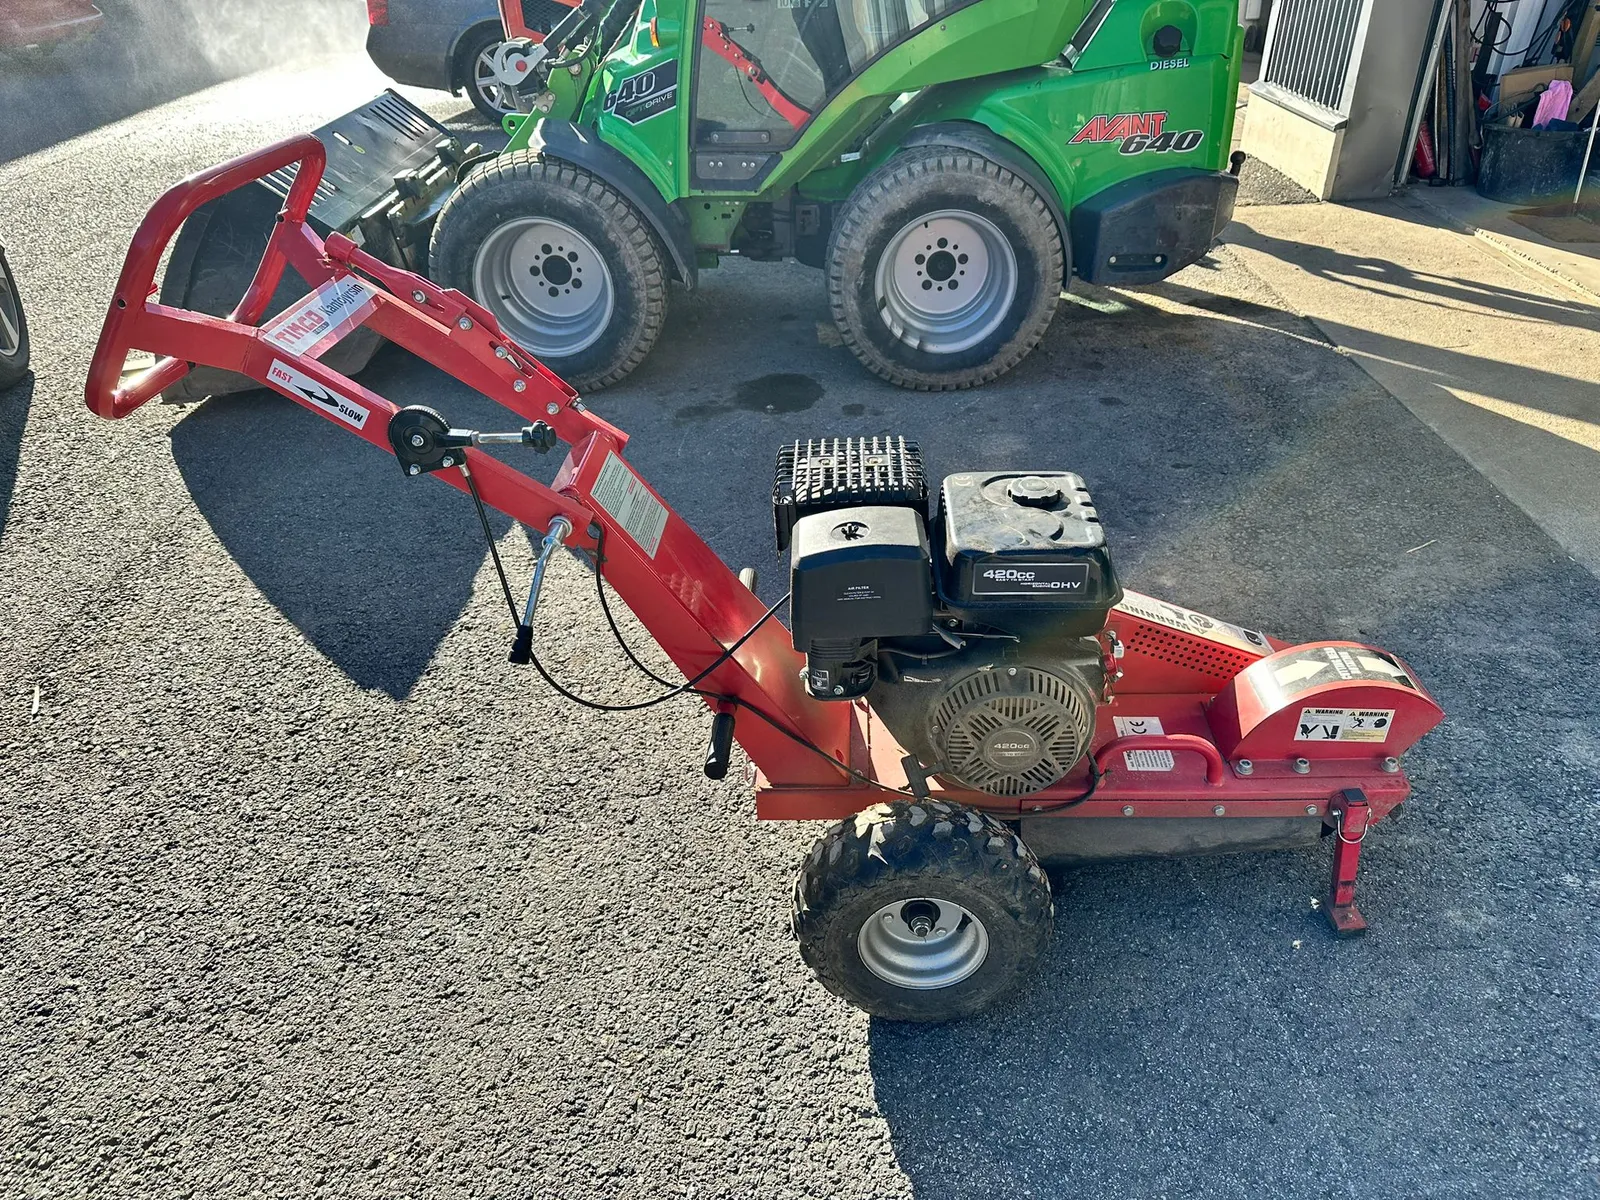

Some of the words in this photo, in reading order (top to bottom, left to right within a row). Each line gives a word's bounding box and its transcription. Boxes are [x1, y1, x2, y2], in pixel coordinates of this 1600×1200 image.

[1149, 58, 1190, 71] DIESEL
[602, 71, 656, 113] 640
[1066, 111, 1168, 145] AVANT
[1118, 129, 1204, 156] 640
[274, 309, 325, 345] TIMCO
[271, 367, 294, 383] FAST
[338, 404, 364, 423] SLOW
[983, 569, 1036, 579] 420cc
[1051, 581, 1081, 589] OHV
